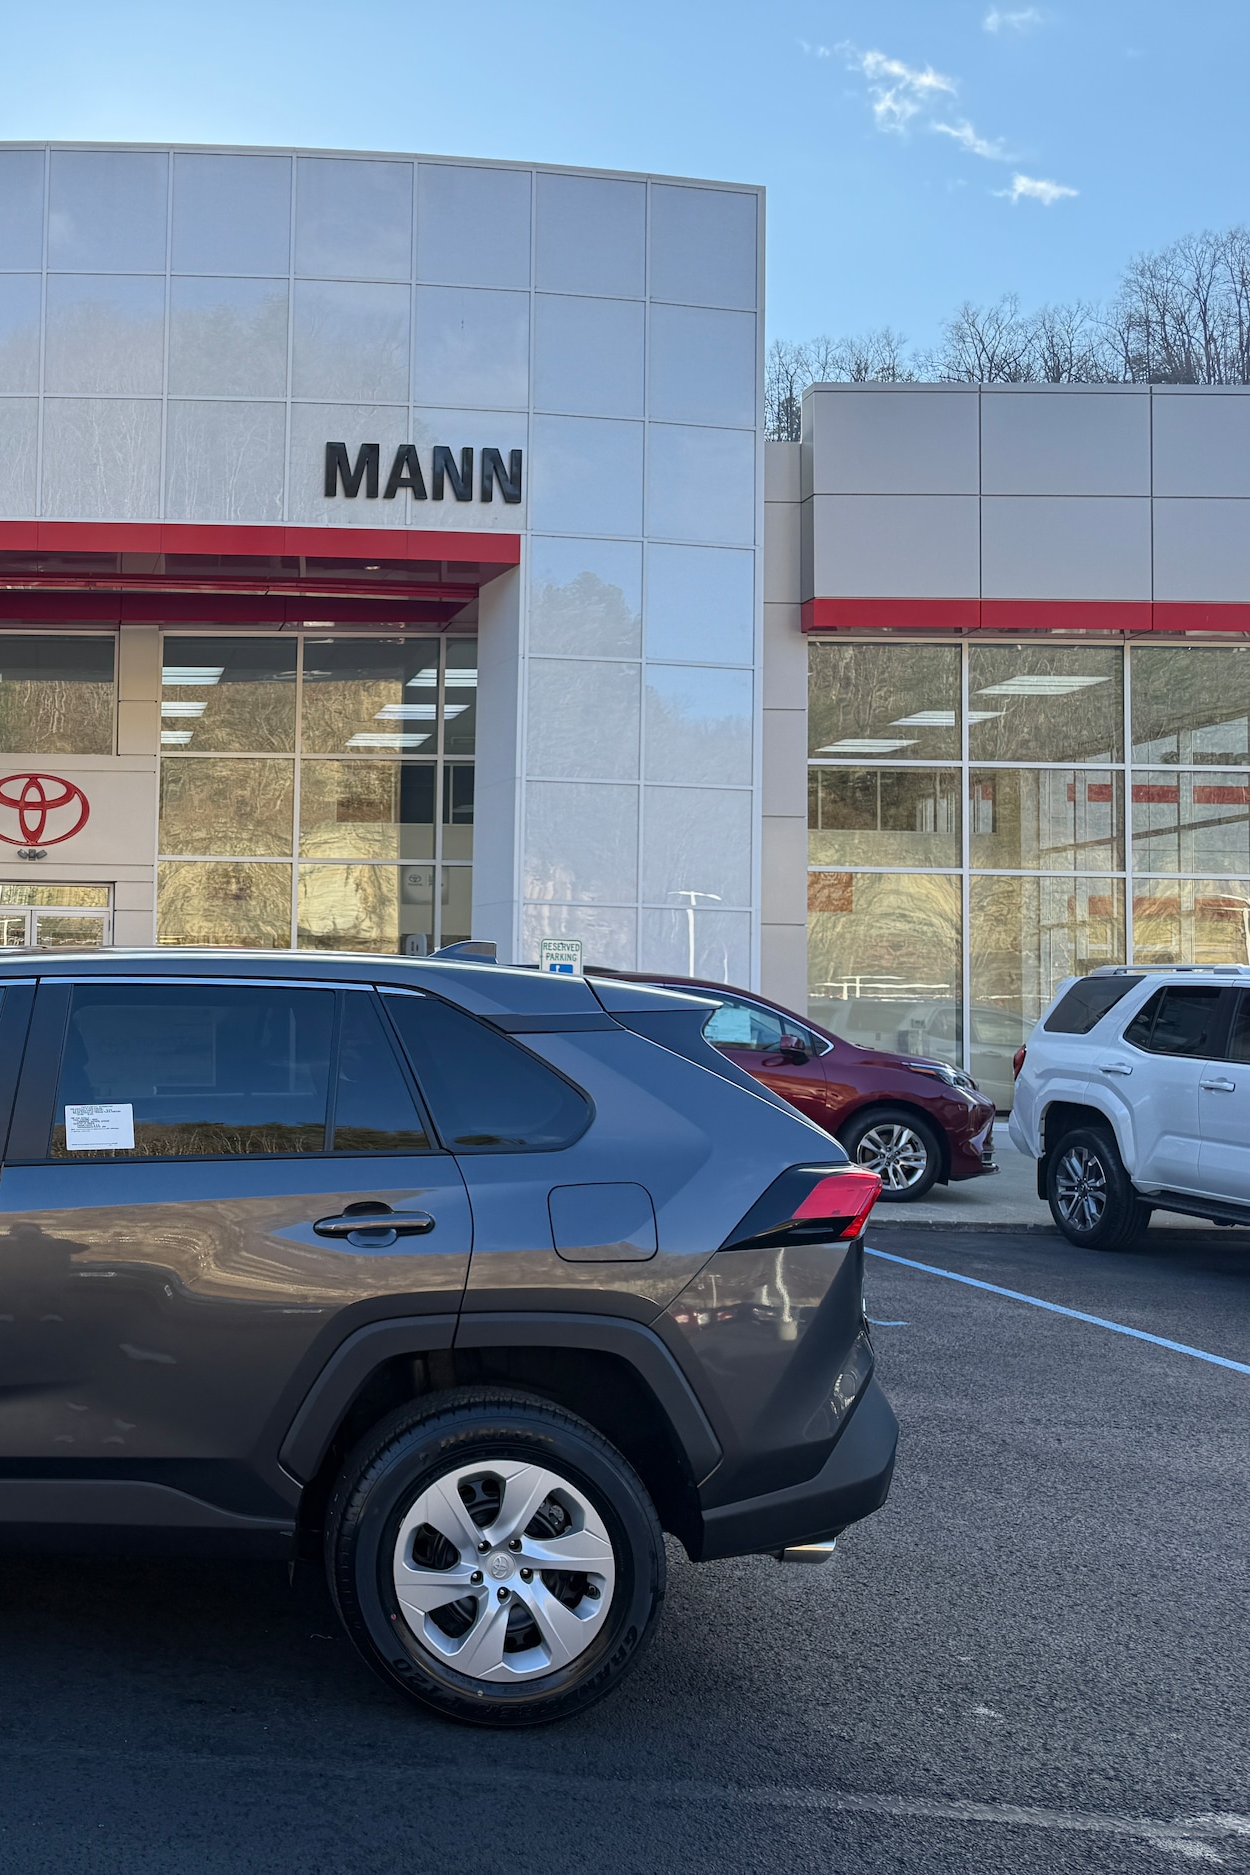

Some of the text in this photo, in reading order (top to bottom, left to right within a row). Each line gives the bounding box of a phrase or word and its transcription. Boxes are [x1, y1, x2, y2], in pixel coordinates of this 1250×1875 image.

[325, 441, 523, 504] MANN
[543, 942, 580, 951] RESERVED
[546, 953, 577, 961] PARKING
